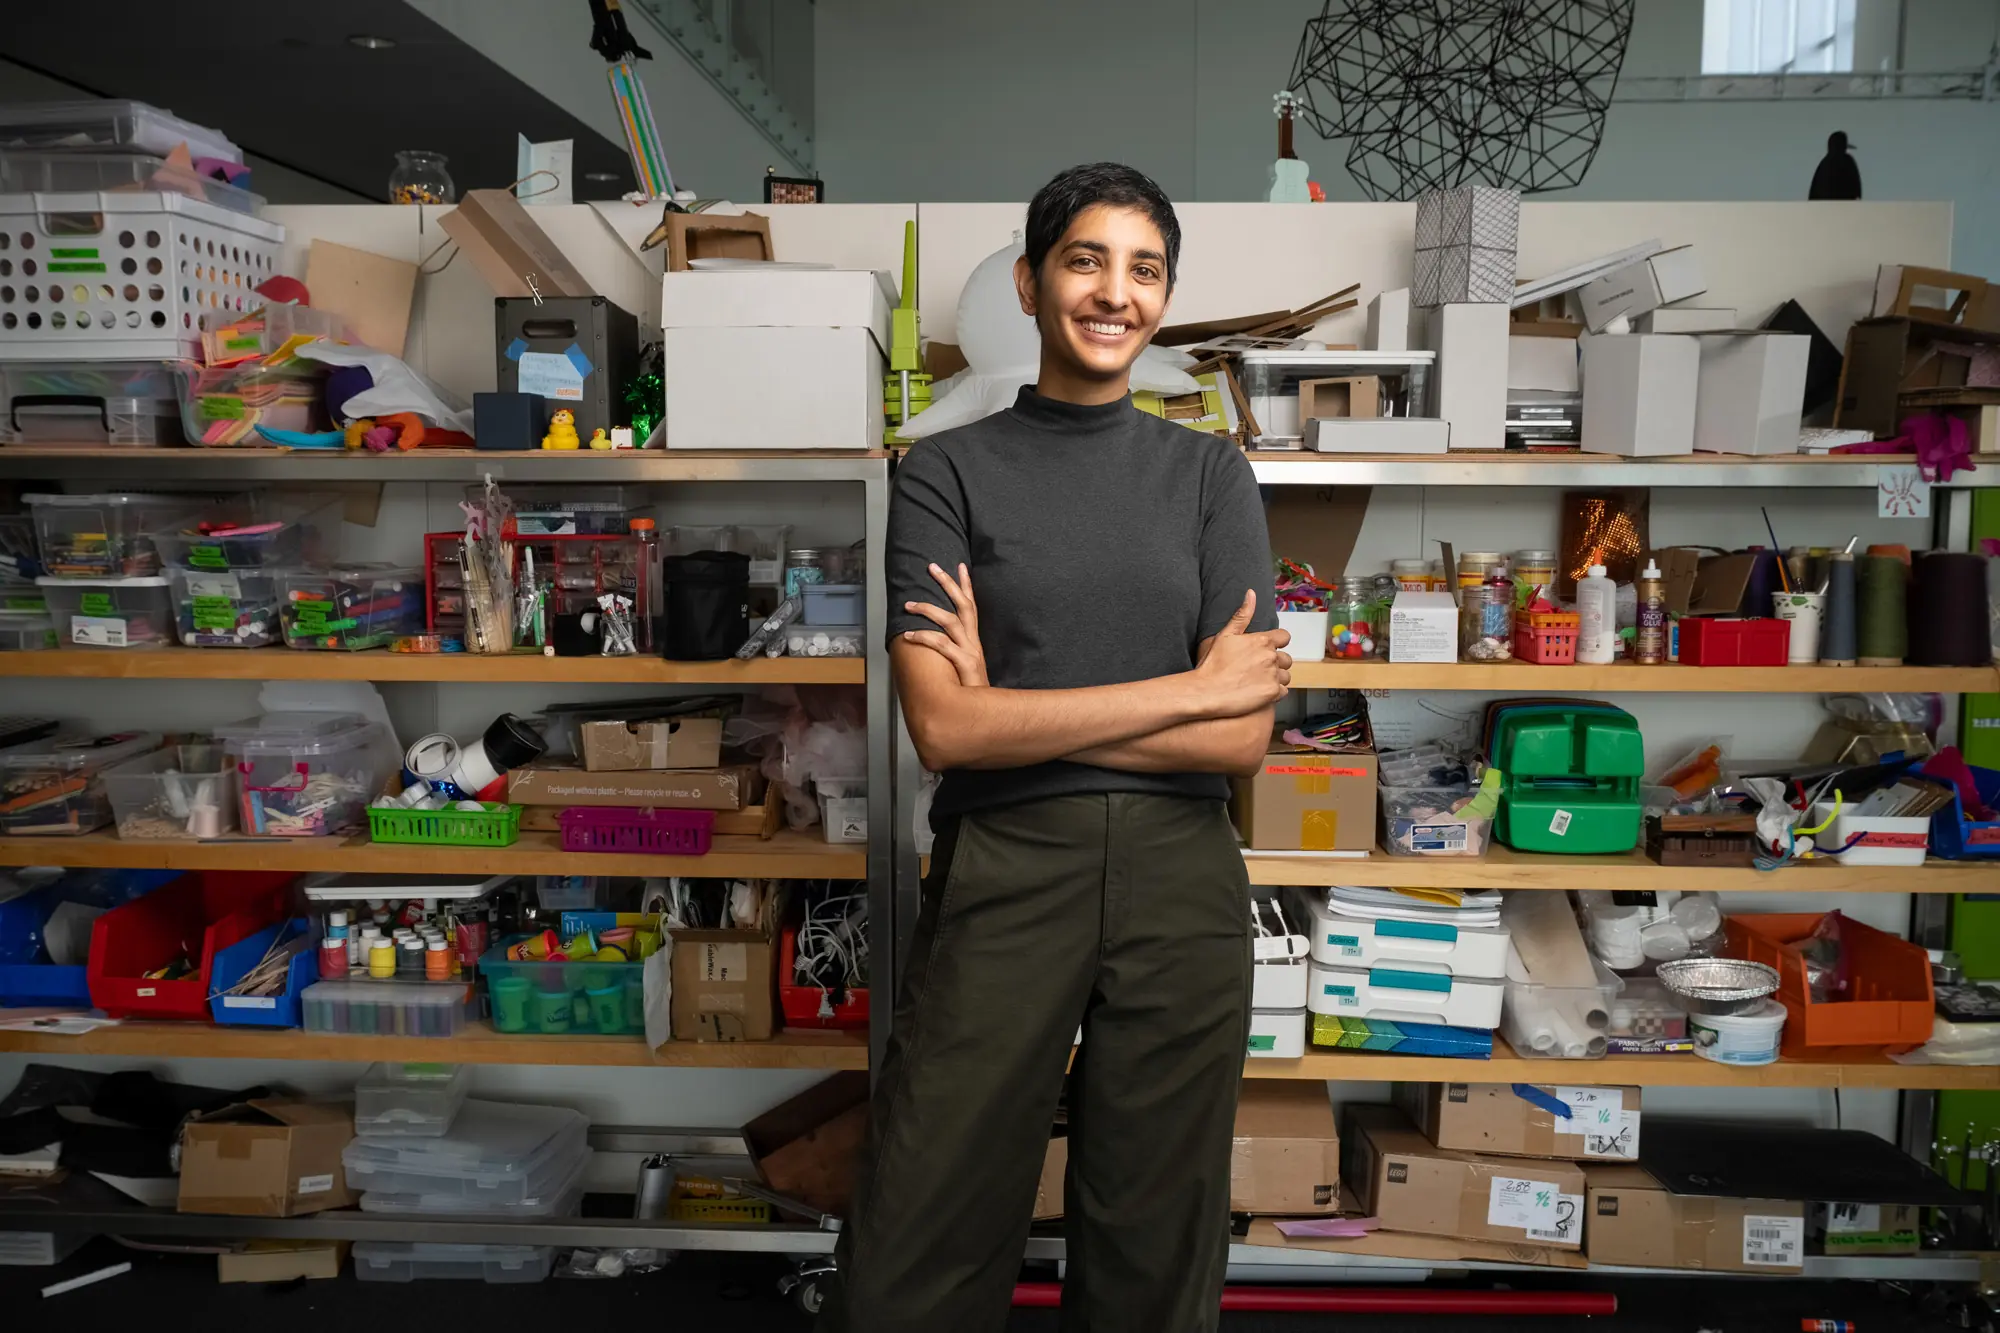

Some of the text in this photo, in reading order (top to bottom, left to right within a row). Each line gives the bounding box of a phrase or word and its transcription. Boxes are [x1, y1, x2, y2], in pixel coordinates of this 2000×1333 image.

[1642, 612, 1663, 620] TACKY
[1643, 619, 1661, 627] GLUE
[547, 785, 575, 796] Packaged
[575, 785, 597, 795] without
[596, 786, 617, 797] plastic
[624, 787, 643, 796] Please
[644, 788, 664, 798] recycle
[1450, 1087, 1467, 1097] LEGO
[1389, 1168, 1406, 1177] LEGO
